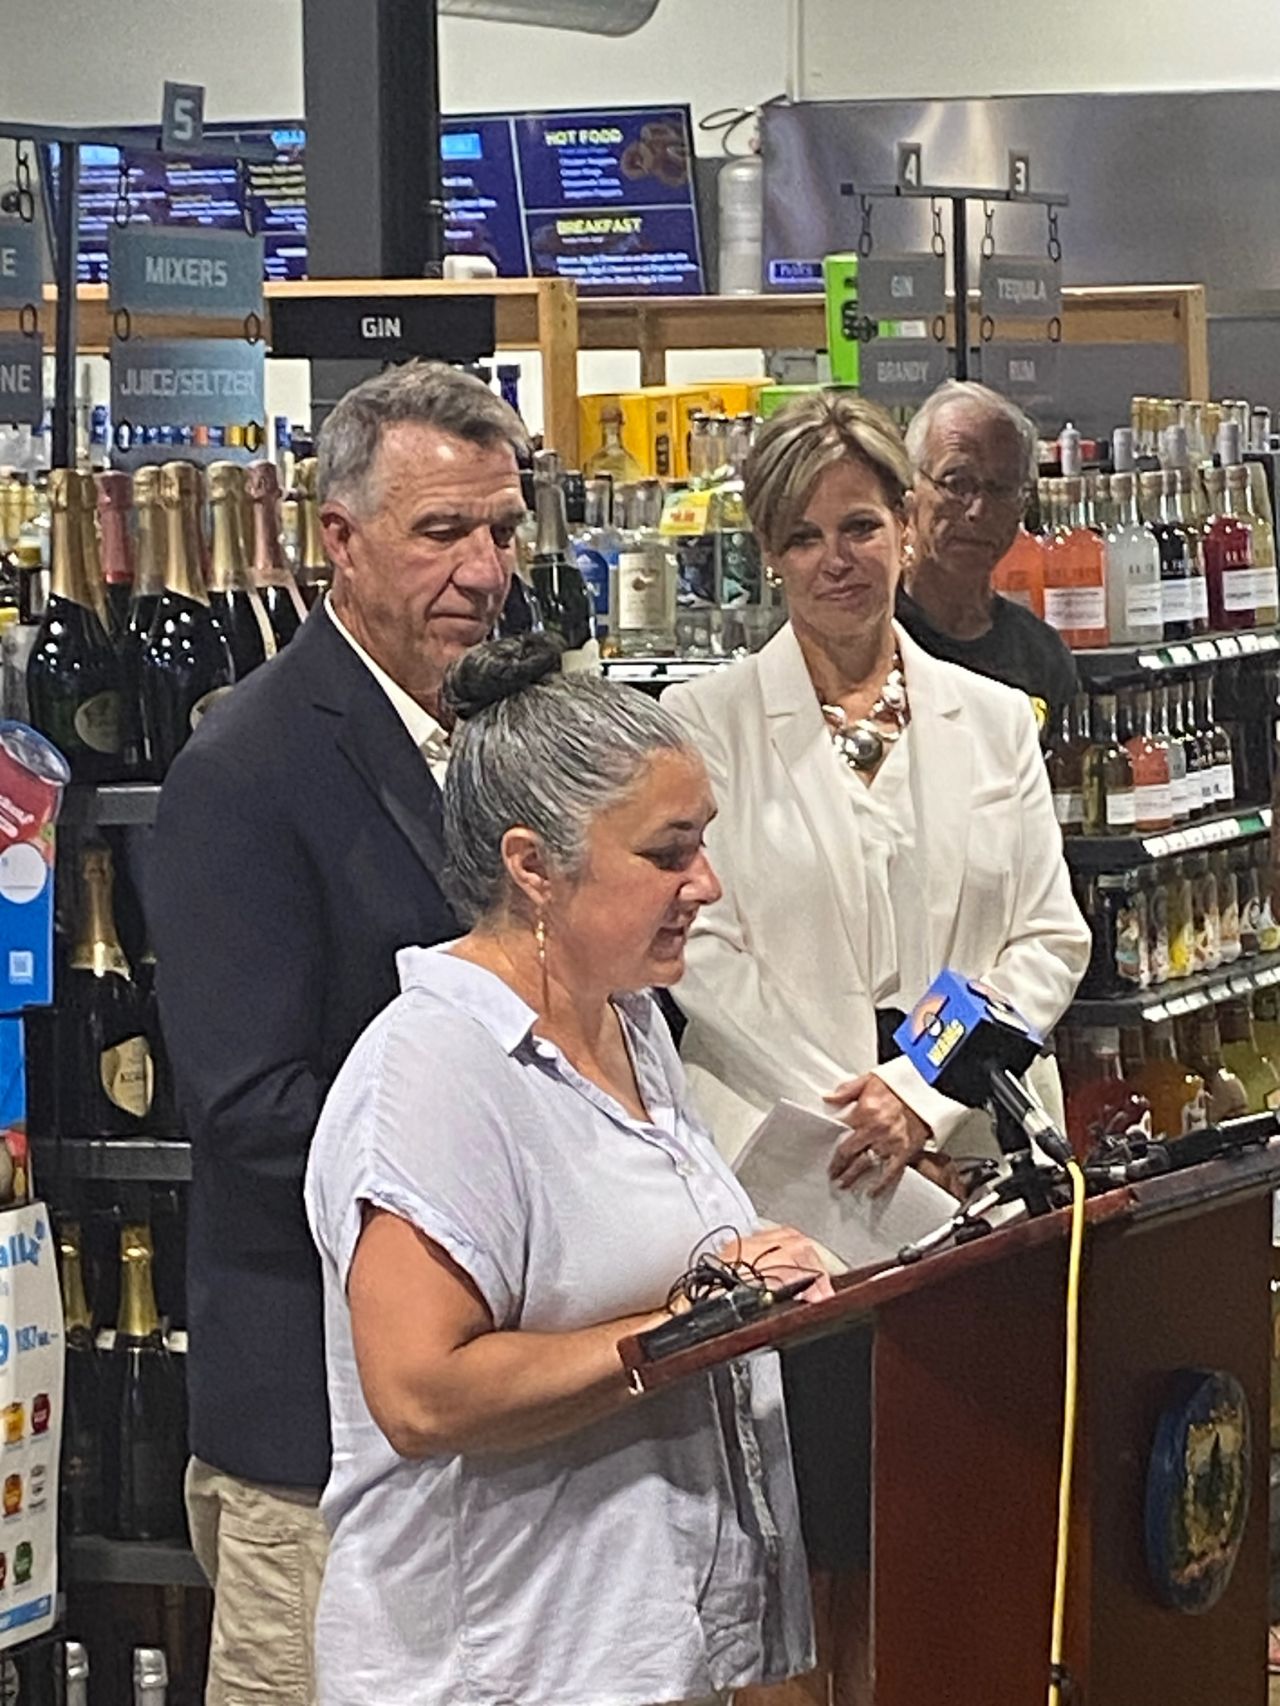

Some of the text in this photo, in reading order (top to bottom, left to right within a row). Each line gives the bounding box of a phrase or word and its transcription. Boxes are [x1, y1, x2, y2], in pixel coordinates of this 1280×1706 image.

[172, 98, 194, 141] 5
[544, 127, 624, 146] HOT FOOD
[904, 153, 918, 187] 4
[1014, 160, 1027, 193] 3
[556, 217, 643, 236] BREAKFAST
[145, 255, 228, 288] MIXERS
[997, 278, 1048, 304] TEQUILA
[361, 317, 402, 338] GIN
[119, 367, 258, 398] JUICE/SELTZER
[876, 360, 929, 382] BRANDY
